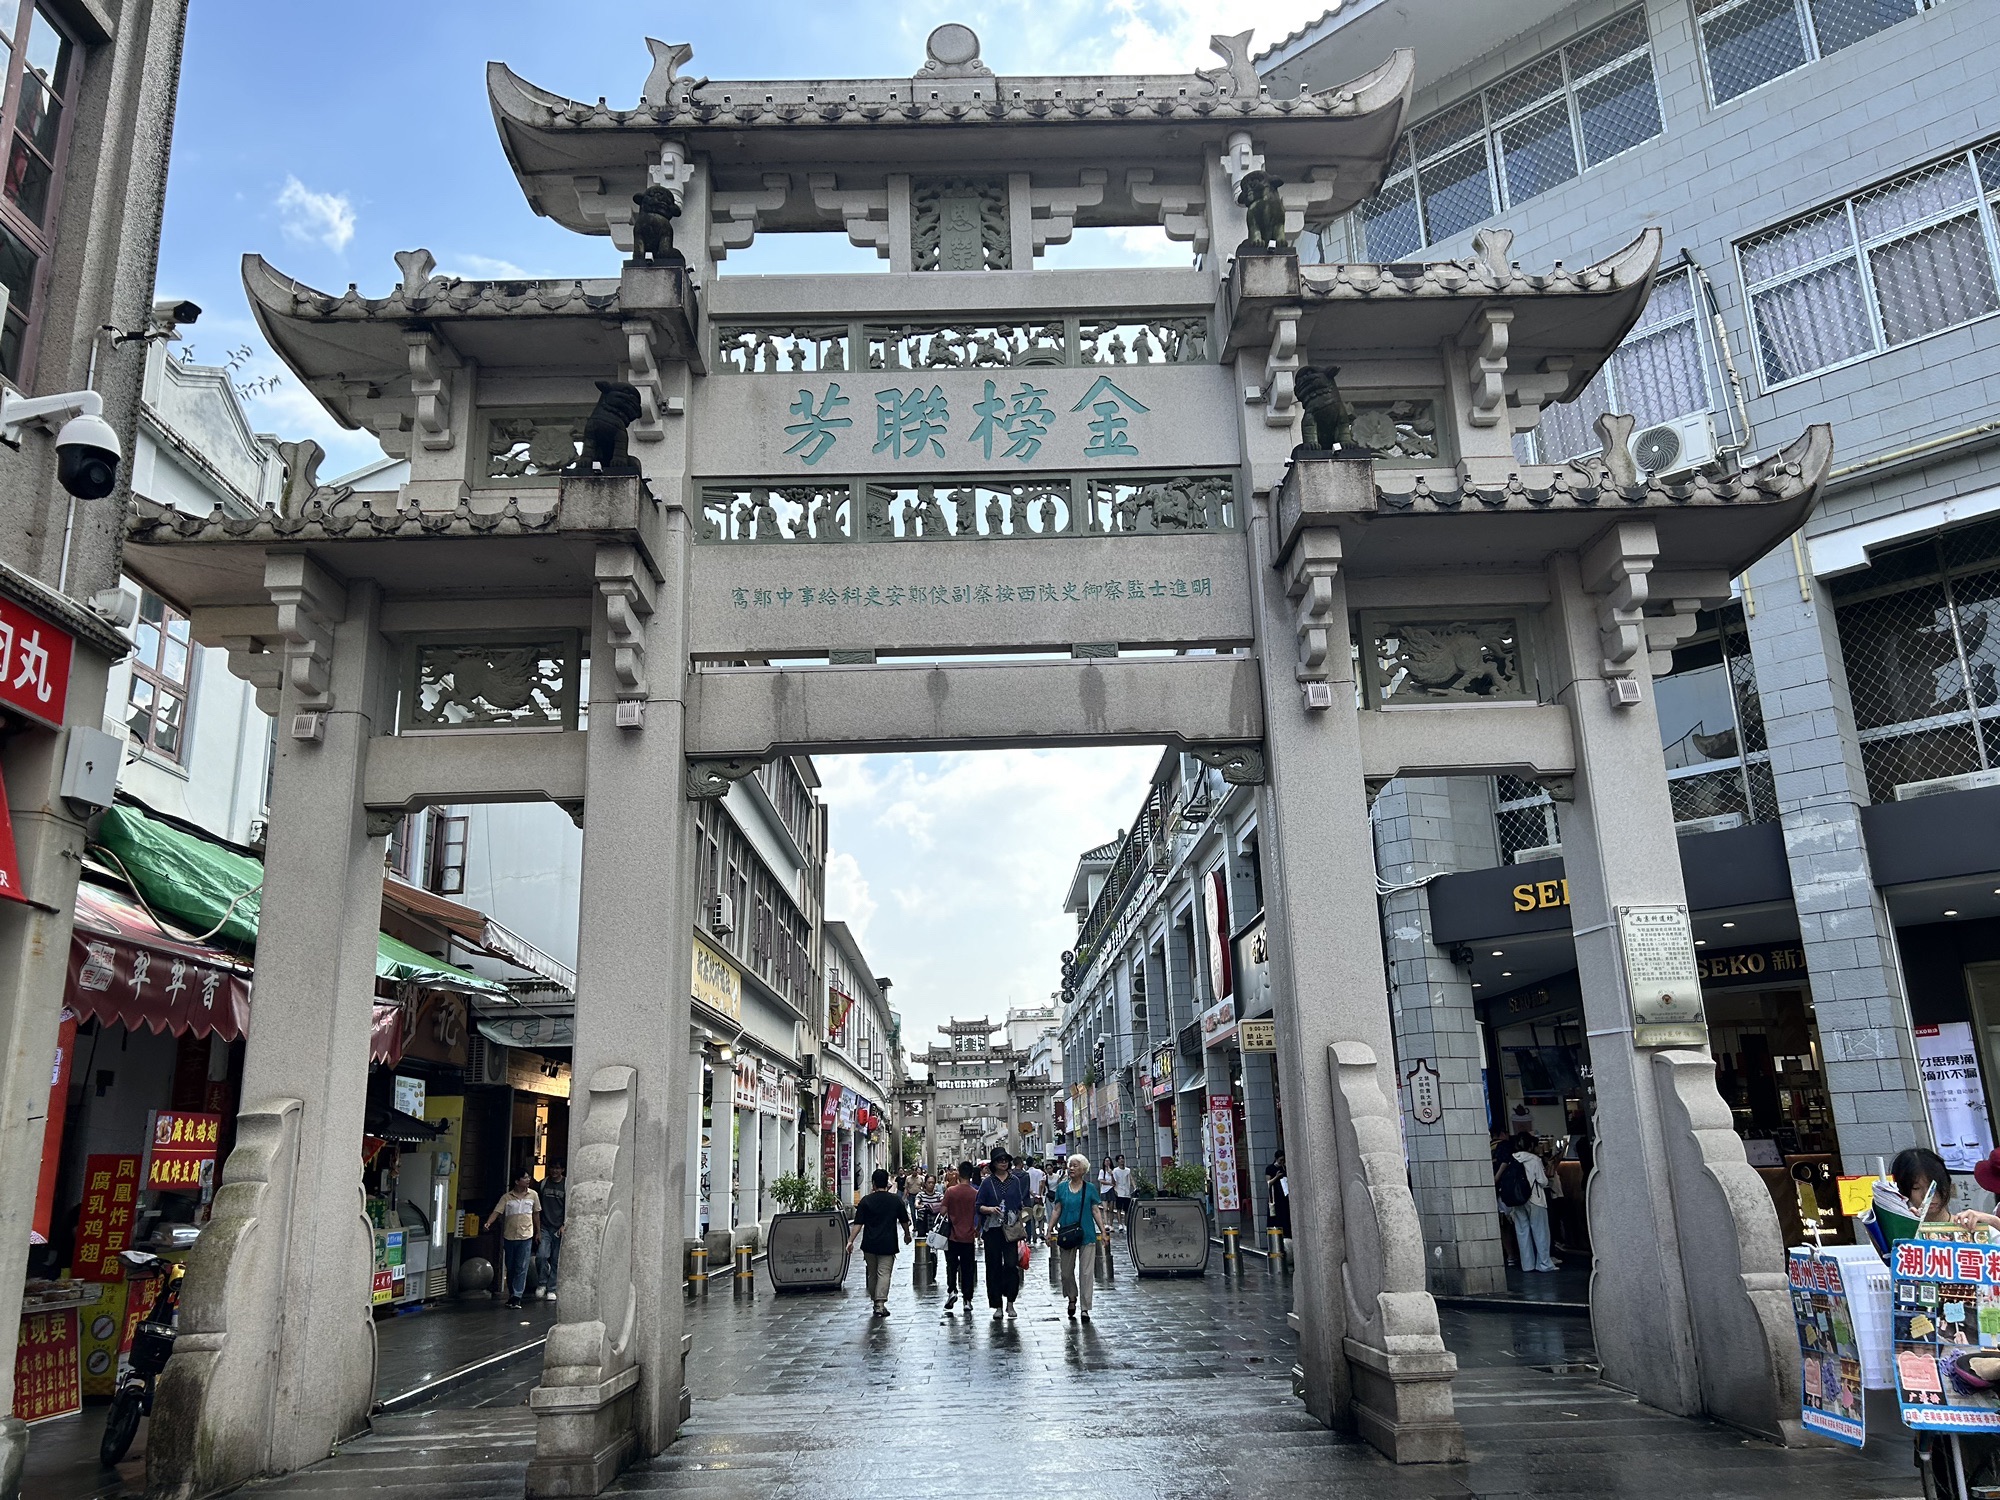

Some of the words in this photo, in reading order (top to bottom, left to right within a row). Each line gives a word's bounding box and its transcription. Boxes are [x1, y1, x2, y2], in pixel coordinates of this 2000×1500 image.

[171, 1117, 218, 1143] 腐乳鸡翅
[149, 1158, 201, 1184] 凤凰炸豆腐
[79, 1170, 112, 1264] 腐乳鸡翅
[100, 1159, 136, 1276] 凤凰炸豆腐
[1789, 1258, 1844, 1294] 潮州雪糕
